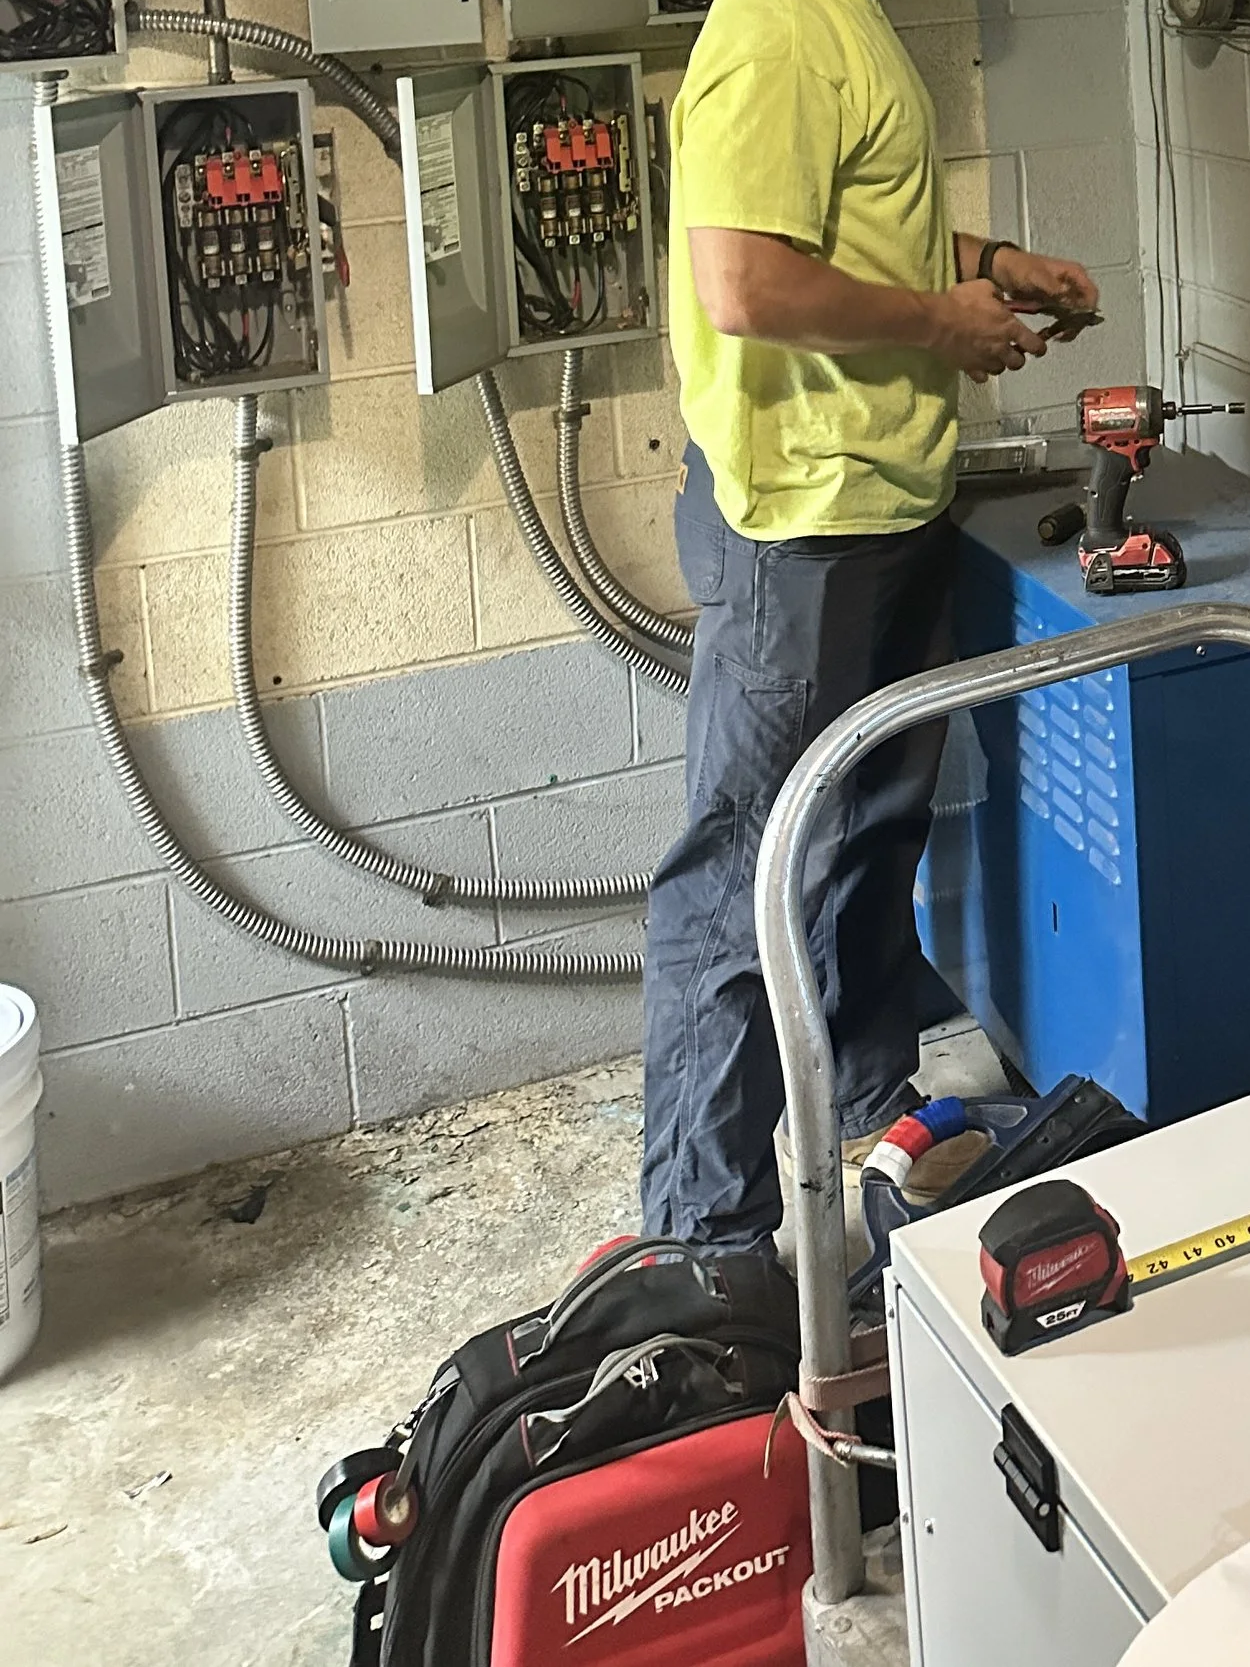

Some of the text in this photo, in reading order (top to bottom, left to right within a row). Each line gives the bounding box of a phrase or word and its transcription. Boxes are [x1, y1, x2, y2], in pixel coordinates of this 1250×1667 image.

[1214, 1234, 1236, 1248] 40
[1183, 1246, 1202, 1261] 41
[1146, 1260, 1169, 1274] 42
[1045, 1308, 1079, 1325] 25FT
[551, 1500, 739, 1625] Milwaukee
[654, 1545, 790, 1614] PACKOUT
